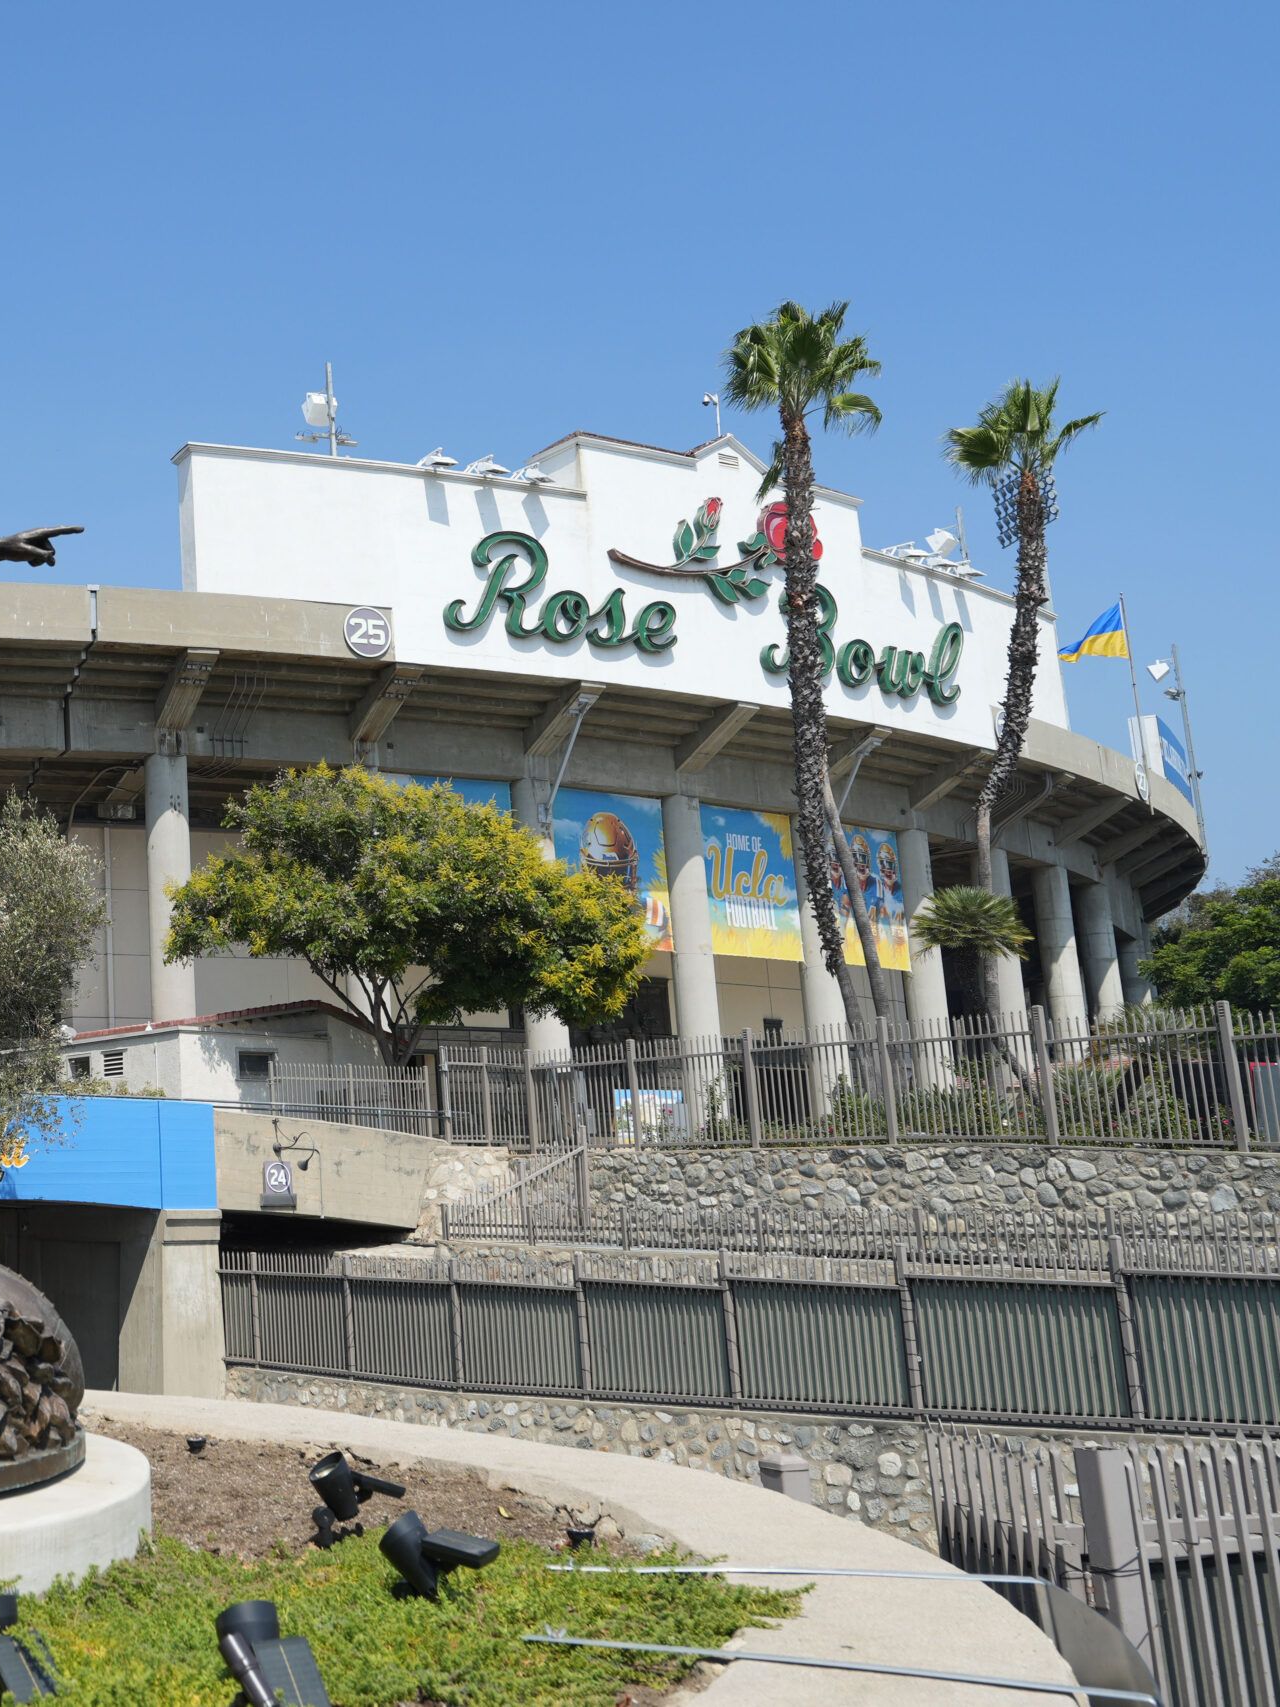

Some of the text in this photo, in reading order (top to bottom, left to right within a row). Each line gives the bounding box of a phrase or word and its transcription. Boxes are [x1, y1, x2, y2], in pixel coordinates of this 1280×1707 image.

[443, 531, 677, 653] Rose
[349, 617, 386, 645] 25
[726, 833, 762, 853] HOME OF
[725, 894, 778, 931] FOOTBALL
[270, 1169, 287, 1185] 24
